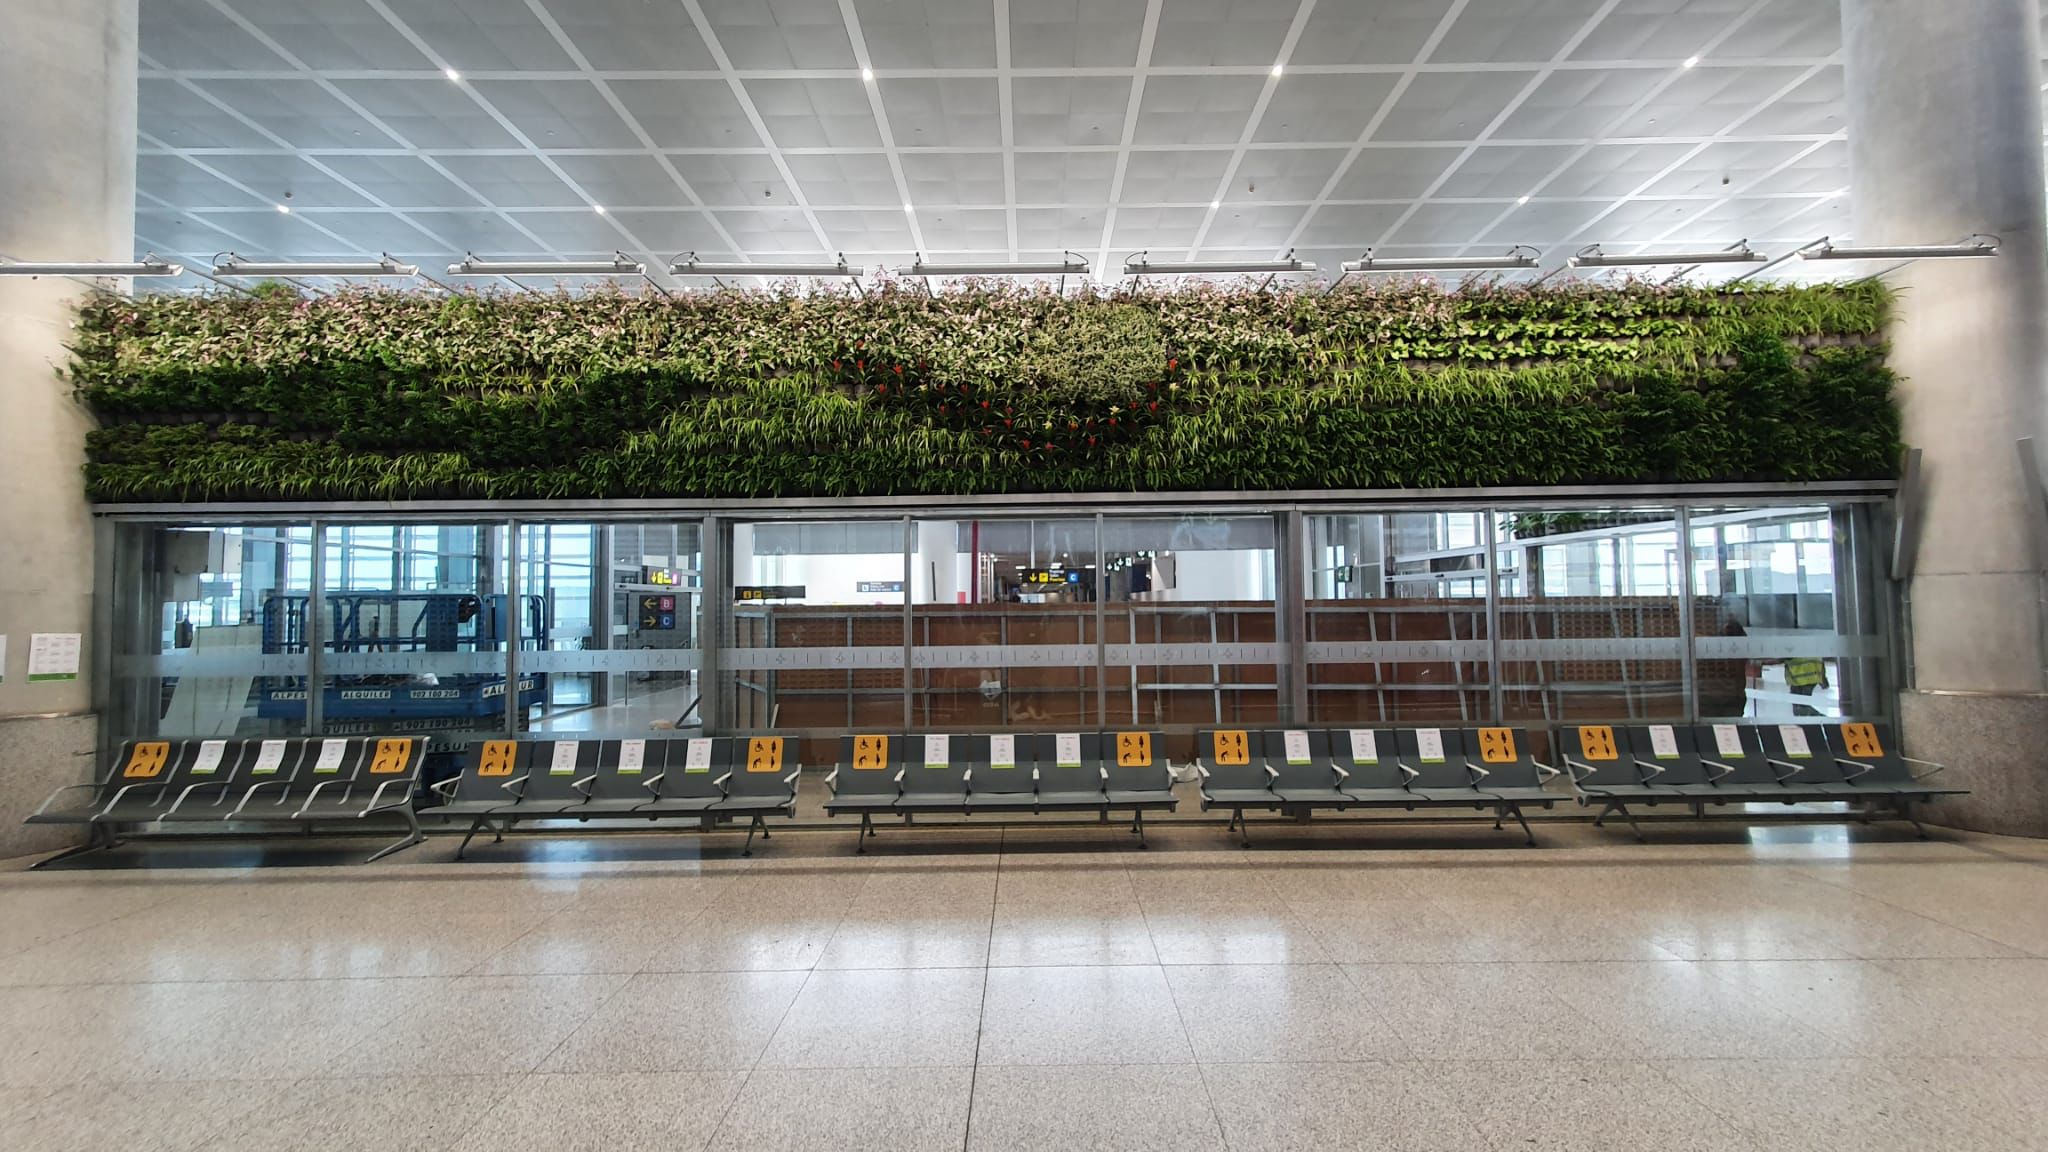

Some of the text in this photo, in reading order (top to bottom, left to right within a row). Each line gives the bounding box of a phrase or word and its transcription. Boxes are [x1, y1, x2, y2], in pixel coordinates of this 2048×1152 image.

[663, 600, 670, 608] B
[663, 617, 670, 626] C
[343, 691, 389, 699] ALQUILER
